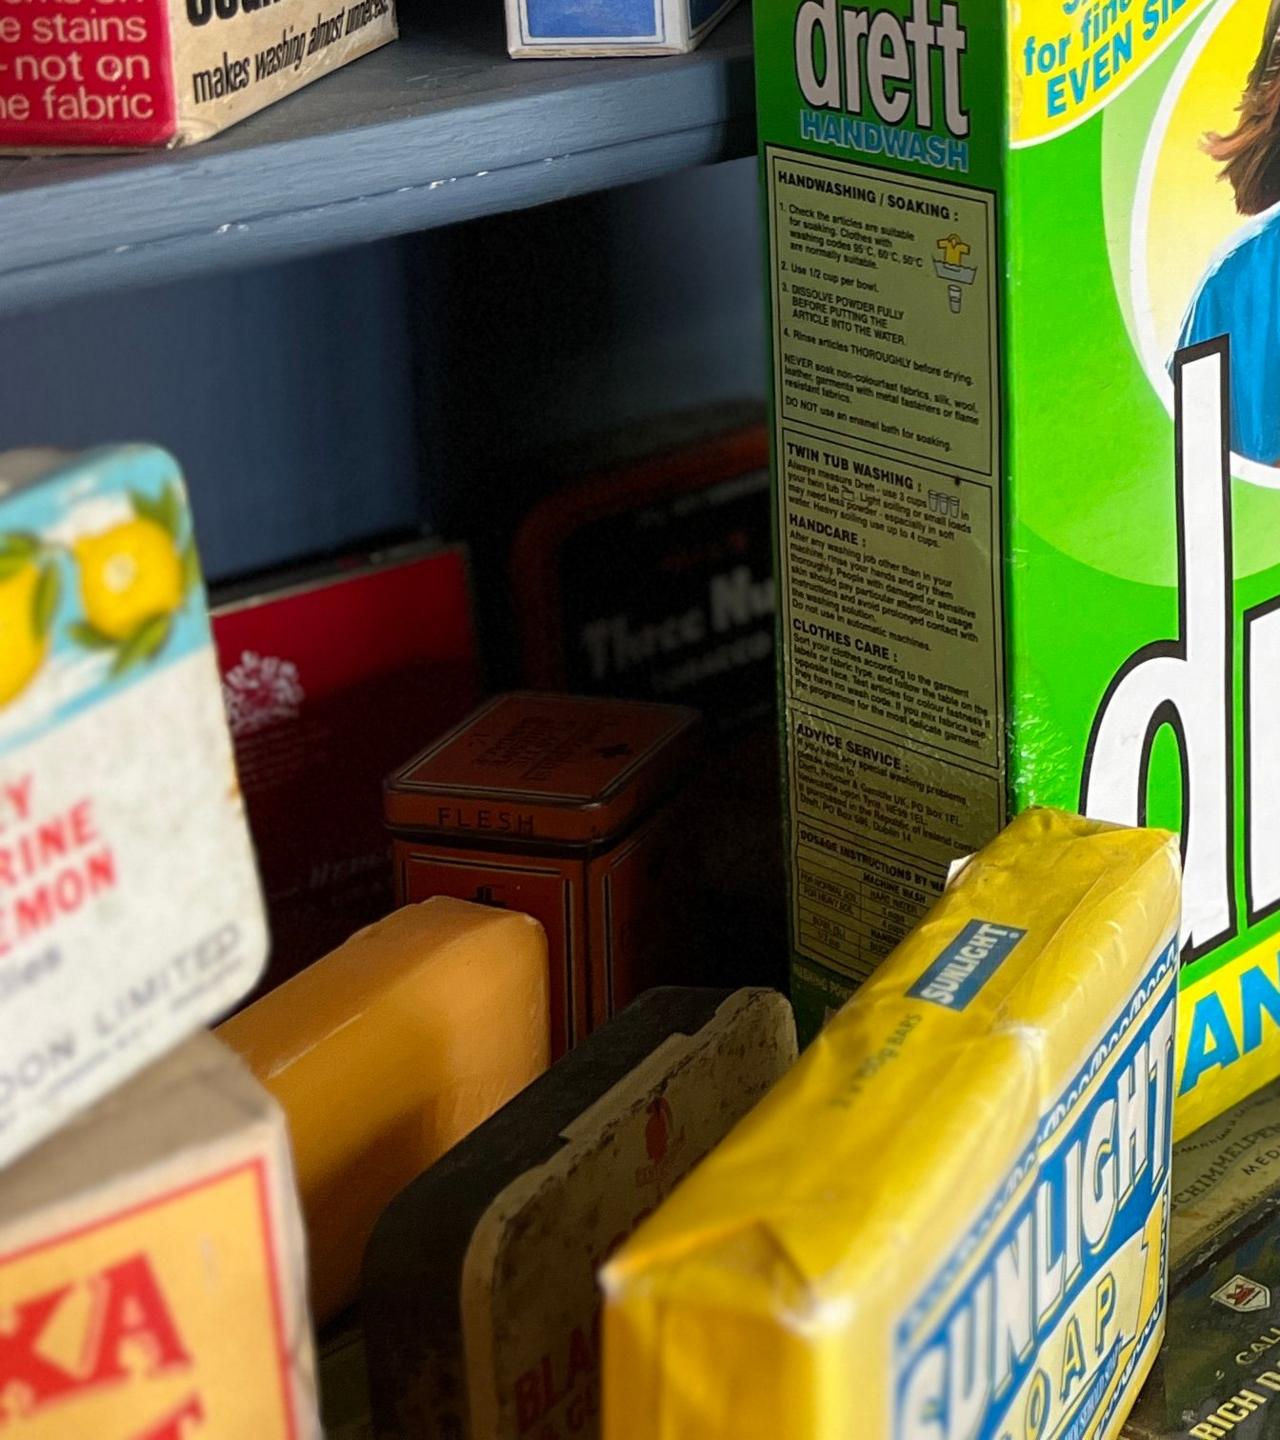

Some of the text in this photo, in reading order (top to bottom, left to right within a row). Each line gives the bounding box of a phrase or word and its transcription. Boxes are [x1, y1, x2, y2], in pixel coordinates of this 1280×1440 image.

[32, 7, 148, 46] stains
[15, 52, 151, 84] not on
[192, 6, 346, 106] makes washing almost
[1023, 34, 1072, 77] for
[1046, 19, 1132, 119] EVEN
[42, 83, 153, 122] fabric
[799, 108, 971, 173] HANDWASH
[778, 170, 950, 220] HANDWASHING SOAKING
[792, 283, 876, 312] DISSOLVE POWDER
[792, 295, 869, 324] BEFORE PUTTING
[792, 308, 830, 327] ARTICLE
[850, 343, 913, 369] THOROUGHLY
[786, 441, 914, 491] TWIN WASHING
[789, 513, 860, 547] HANDCARE
[792, 618, 891, 662] CLOTHES CARE
[437, 807, 536, 833] FLESH
[921, 923, 1012, 1005] SUNLIGHT
[1002, 1271, 1117, 1440] OAP
[1189, 1389, 1267, 1440] RICH
